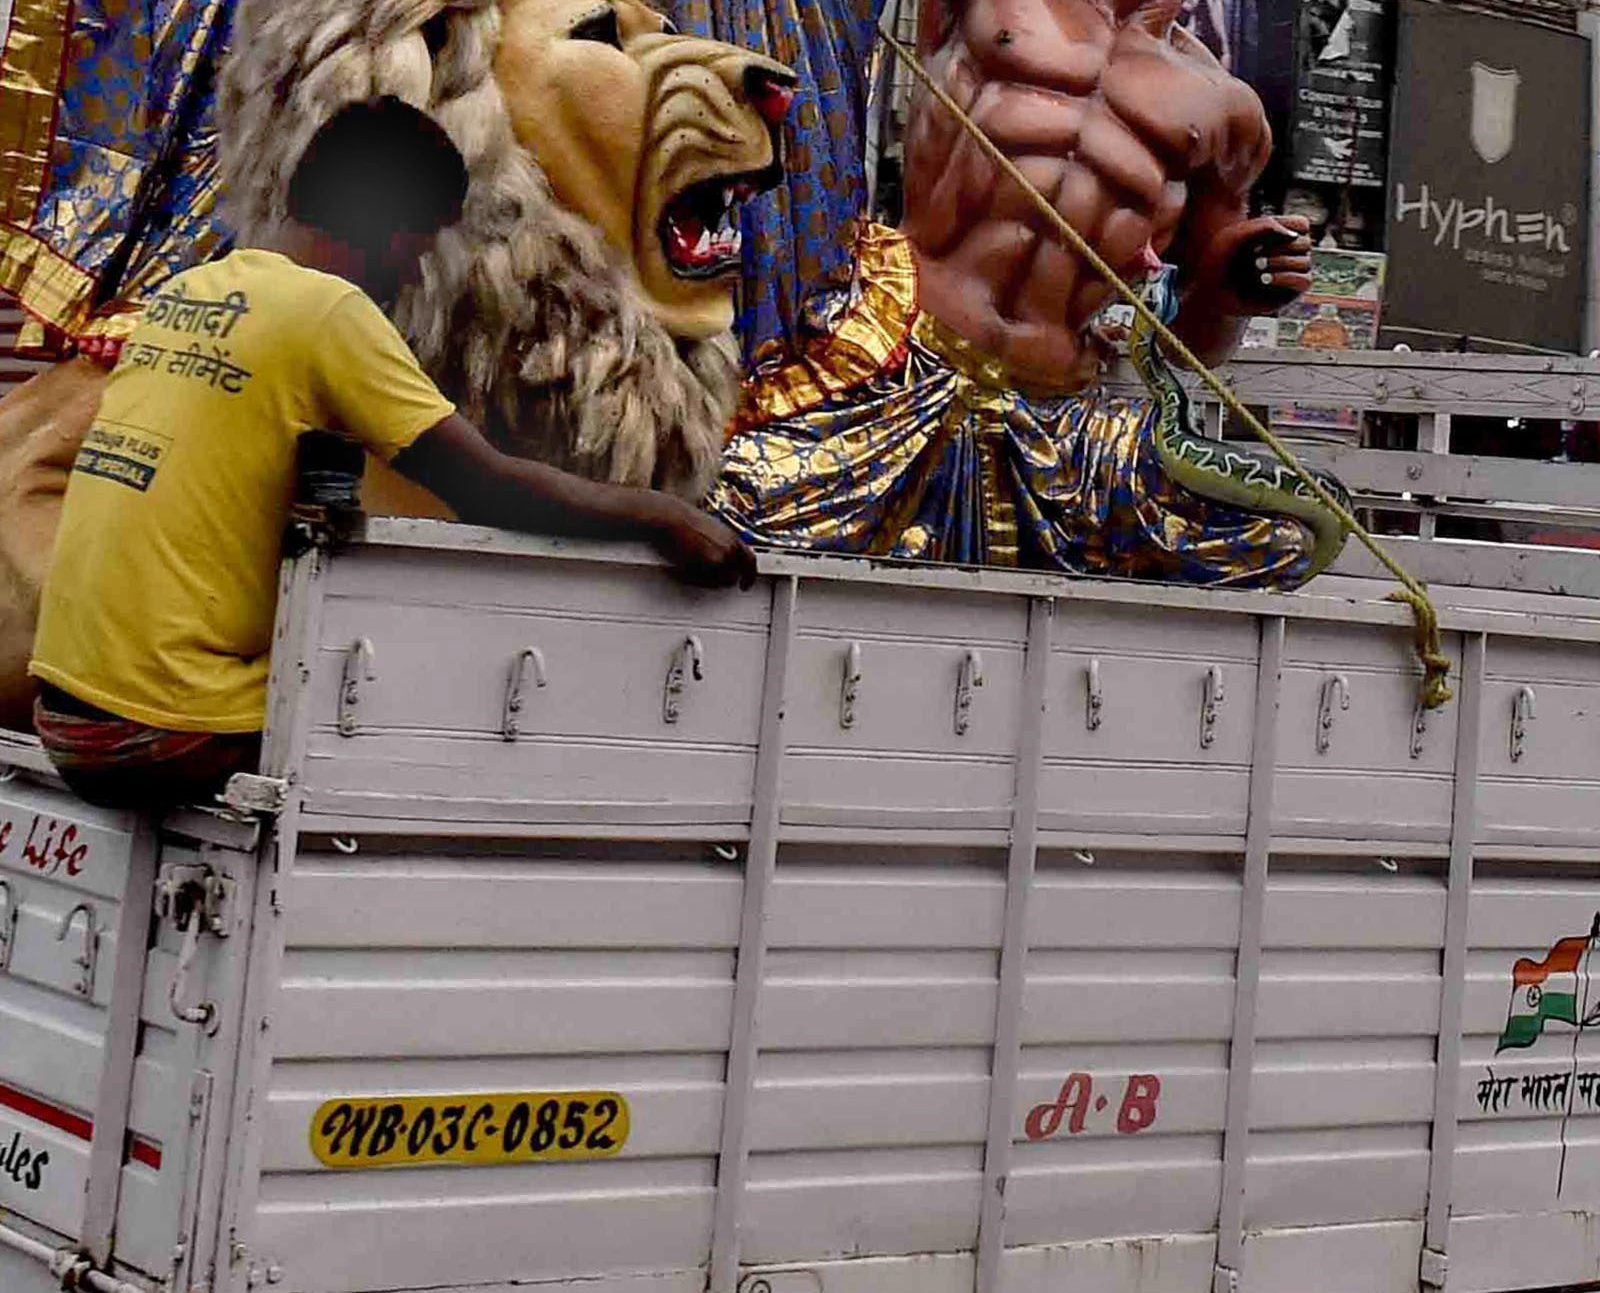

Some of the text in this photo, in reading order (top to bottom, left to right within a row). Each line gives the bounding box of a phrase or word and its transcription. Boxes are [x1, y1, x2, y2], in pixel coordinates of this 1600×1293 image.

[1395, 182, 1572, 254] Hyphen
[21, 814, 89, 877] Life
[1476, 1065, 1518, 1113] मेरा
